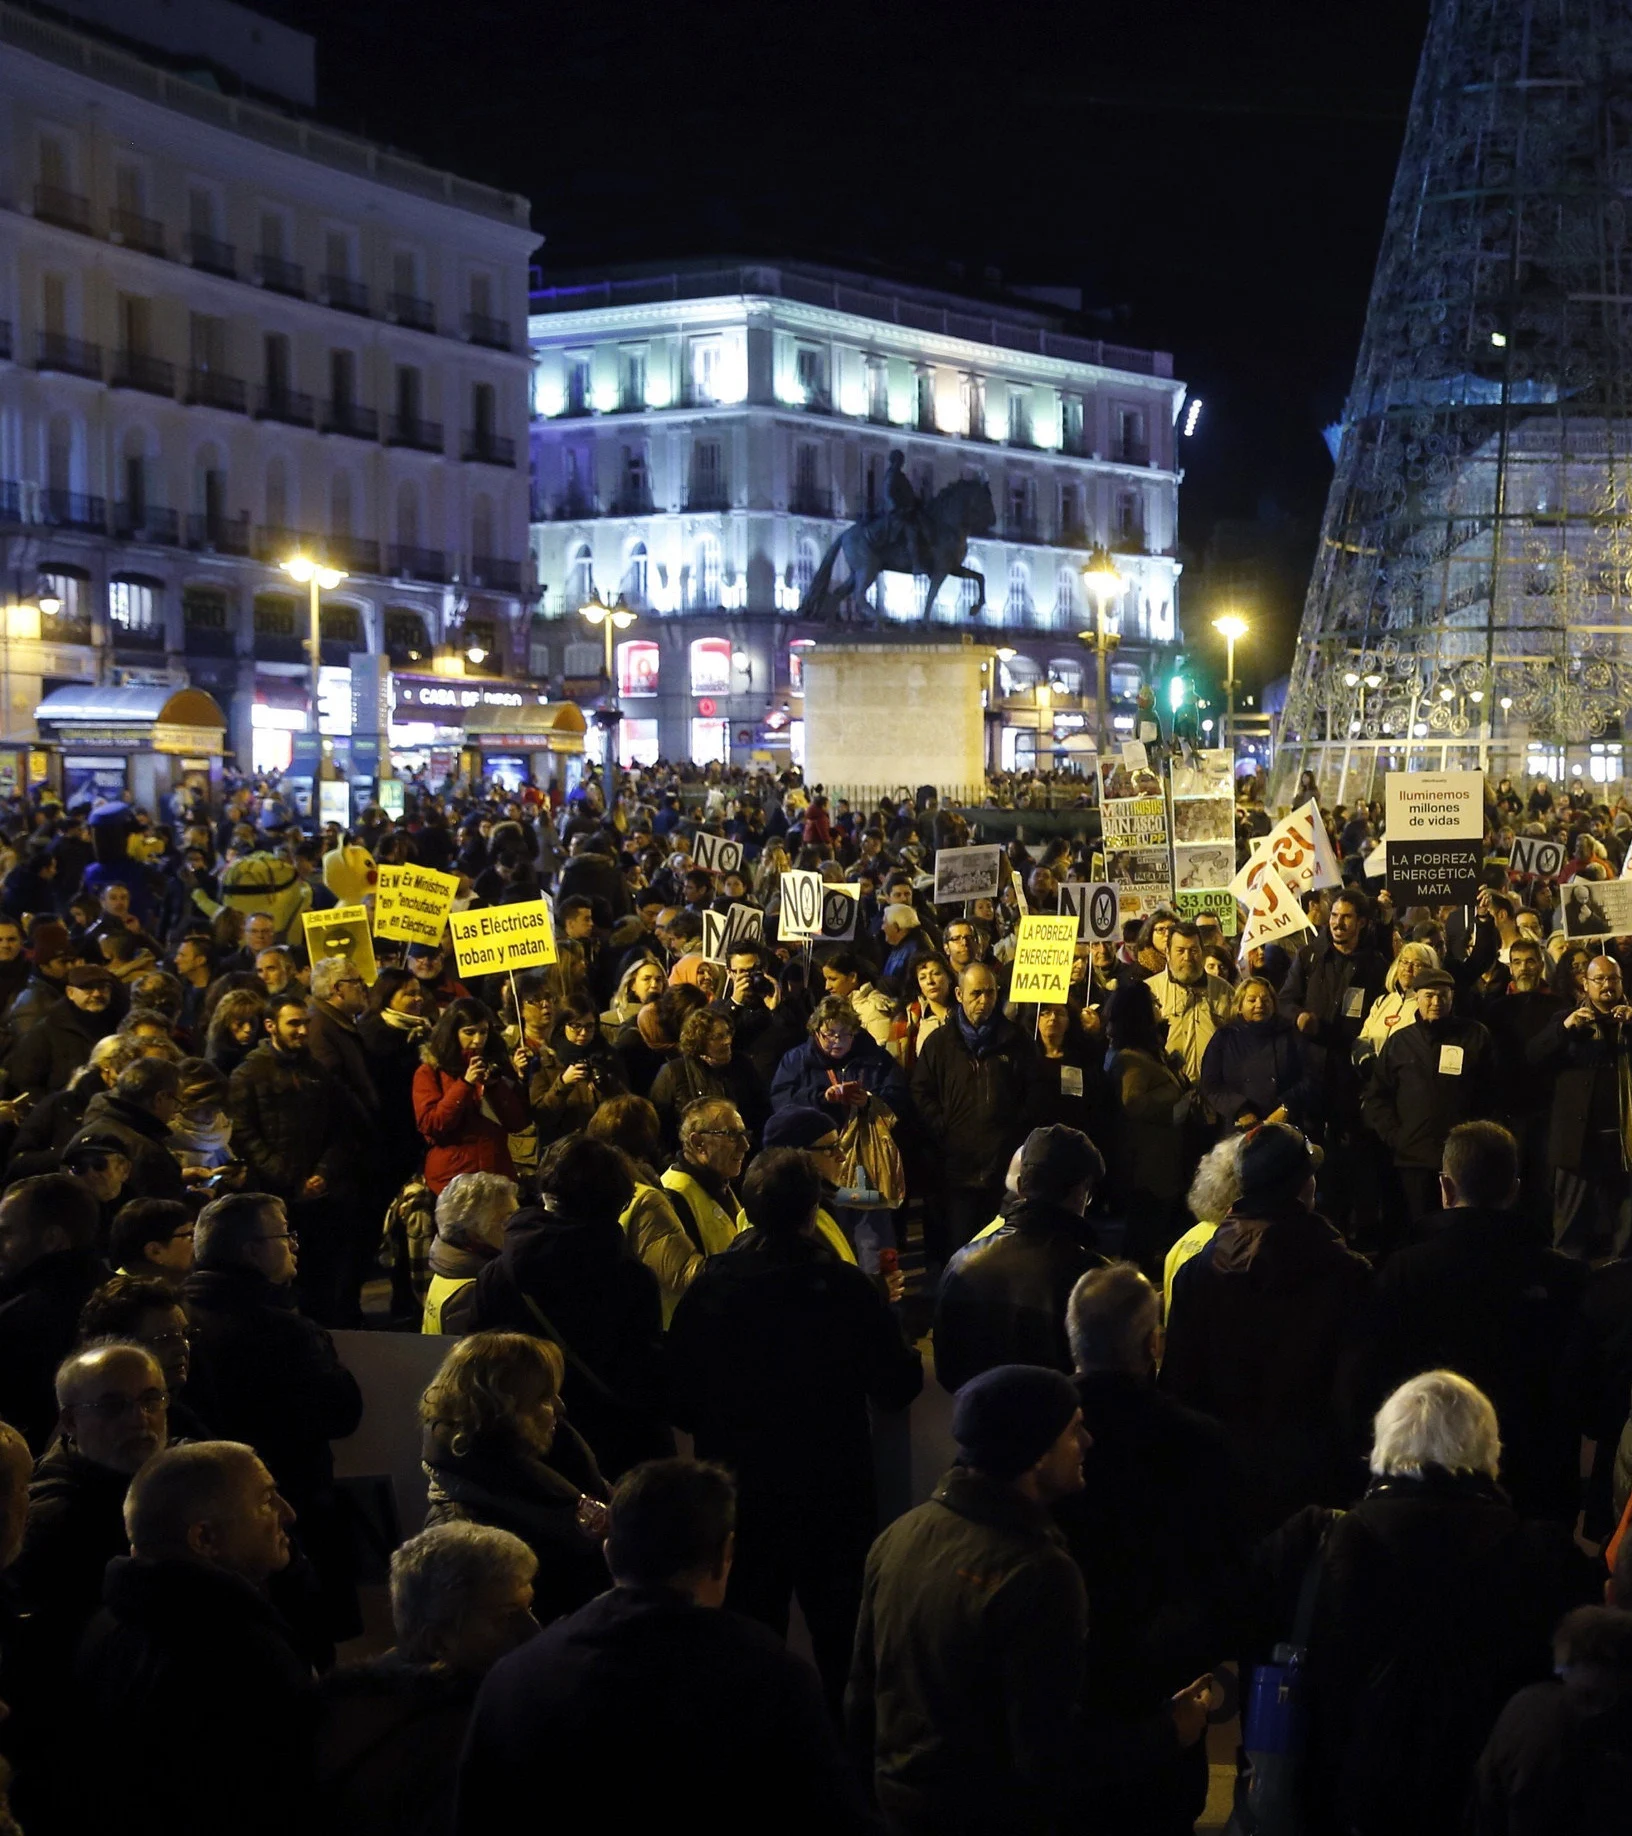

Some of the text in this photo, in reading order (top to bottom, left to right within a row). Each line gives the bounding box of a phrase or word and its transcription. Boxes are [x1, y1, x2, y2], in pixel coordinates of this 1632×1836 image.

[419, 688, 456, 706] CASA
[1399, 790, 1470, 801] Iluminemos
[1409, 803, 1460, 813] millones
[1133, 815, 1161, 832] ASCO
[1409, 815, 1460, 826] de vidas
[693, 834, 740, 873] NO
[1392, 853, 1476, 865] LA POBREZA
[1510, 838, 1561, 877] NO
[1393, 867, 1476, 880] ENERGÉTICA
[1417, 884, 1452, 895] MATA
[783, 876, 815, 929] NO
[1180, 893, 1233, 909] 33.000
[1060, 885, 1118, 939] NO
[453, 912, 545, 941] Las Eléctricas
[1023, 924, 1073, 941] LA POBREZA
[459, 938, 550, 967] roban y matan.
[1019, 944, 1070, 966] ENERGÉTICA
[1015, 973, 1066, 991] MATA.
